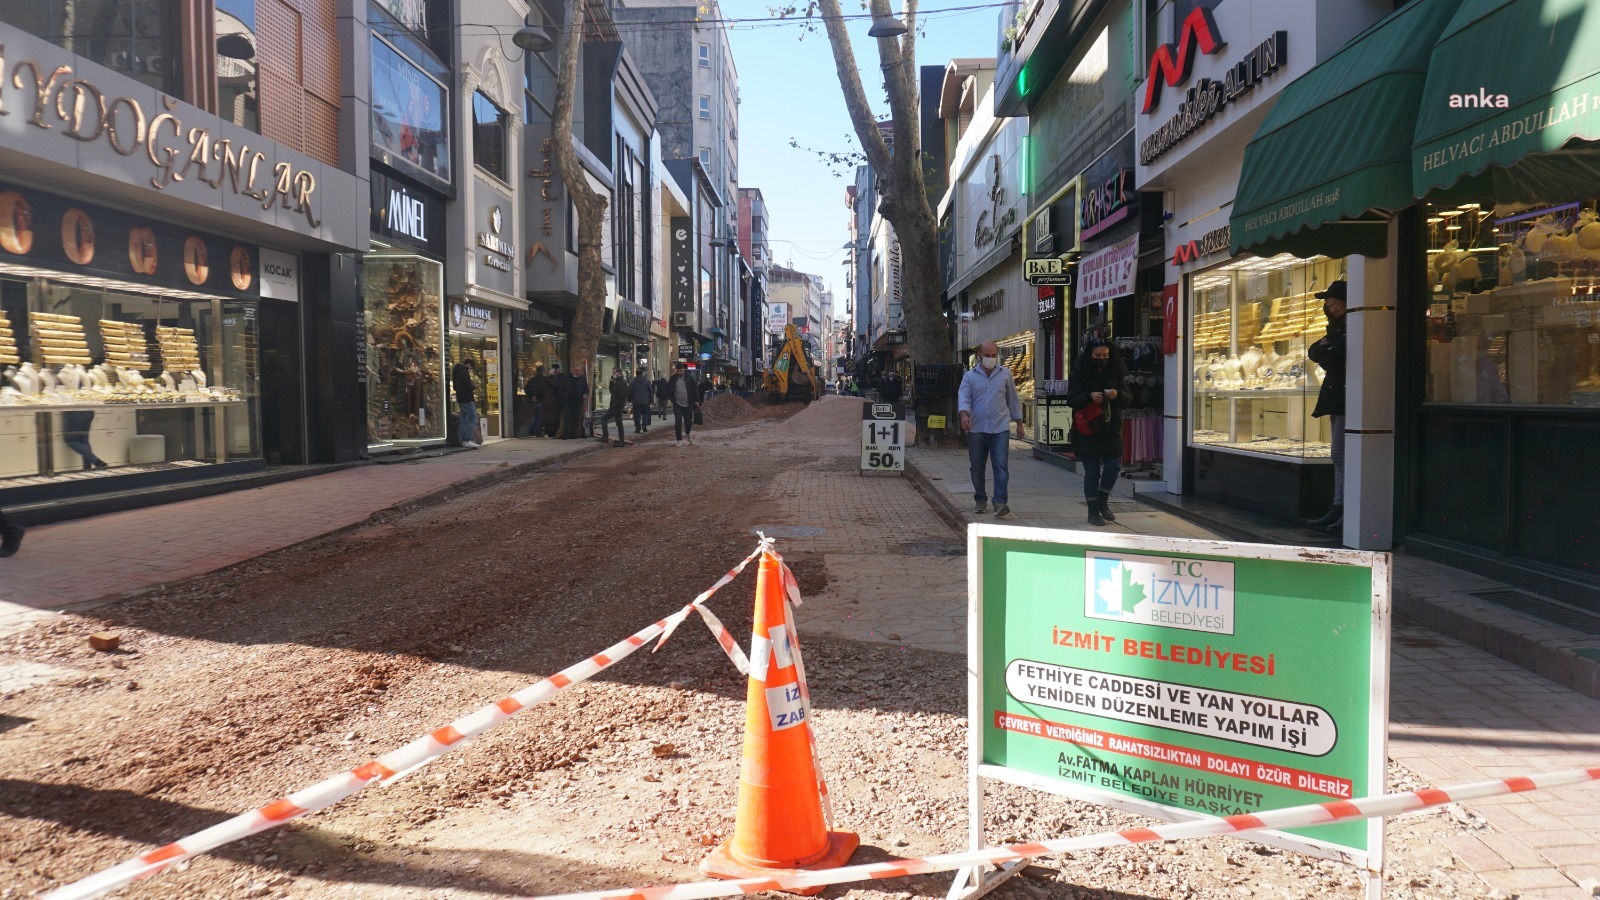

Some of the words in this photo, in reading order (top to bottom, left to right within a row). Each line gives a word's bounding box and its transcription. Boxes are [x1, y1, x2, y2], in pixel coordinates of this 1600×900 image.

[1223, 31, 1281, 104] ALTIN
[0, 45, 322, 229] YDOĞANLAR
[1423, 133, 1487, 172] HELVACI
[1488, 92, 1589, 148] ABDULLAH
[388, 187, 428, 243] MİNEL
[1244, 213, 1277, 232] HELVACI
[1278, 193, 1323, 221] ABDULLAH
[1029, 260, 1058, 274] B&E
[868, 422, 899, 445] 1+1
[1151, 572, 1224, 610] İZMİT
[1151, 608, 1225, 631] BELEDİYESİ
[1052, 625, 1116, 654] İZMİT
[1123, 638, 1276, 677] BELEDİYESİ
[777, 708, 804, 727] ZAB
[785, 688, 799, 703] İZ
[1017, 663, 1083, 688] FETHİYE
[1088, 674, 1162, 701] CADDESİ
[1167, 687, 1191, 705] VE
[1195, 691, 1234, 712] YAN
[1240, 698, 1320, 727] YOLLAR
[1026, 682, 1096, 710] YENİDEN
[1101, 694, 1208, 729] DÜZENLEME
[1213, 716, 1275, 741] YAPIM
[1281, 724, 1308, 749] İŞİ
[998, 715, 1042, 736] ÇEVREYE
[1046, 722, 1104, 747] VERDİĞİMİZ
[1109, 737, 1201, 767] RAHATSIZLIKTAN
[1207, 756, 1250, 777] DOLAYI
[1256, 762, 1292, 786] ÖZÜR
[1298, 774, 1350, 797] DİLERİZ
[1057, 751, 1119, 777] Av.FATMA
[1123, 765, 1180, 790] KAPLAN
[1185, 778, 1264, 808] HÜRRİYET
[1058, 766, 1095, 785] İZMİT
[1100, 777, 1179, 803] BELEDİYE
